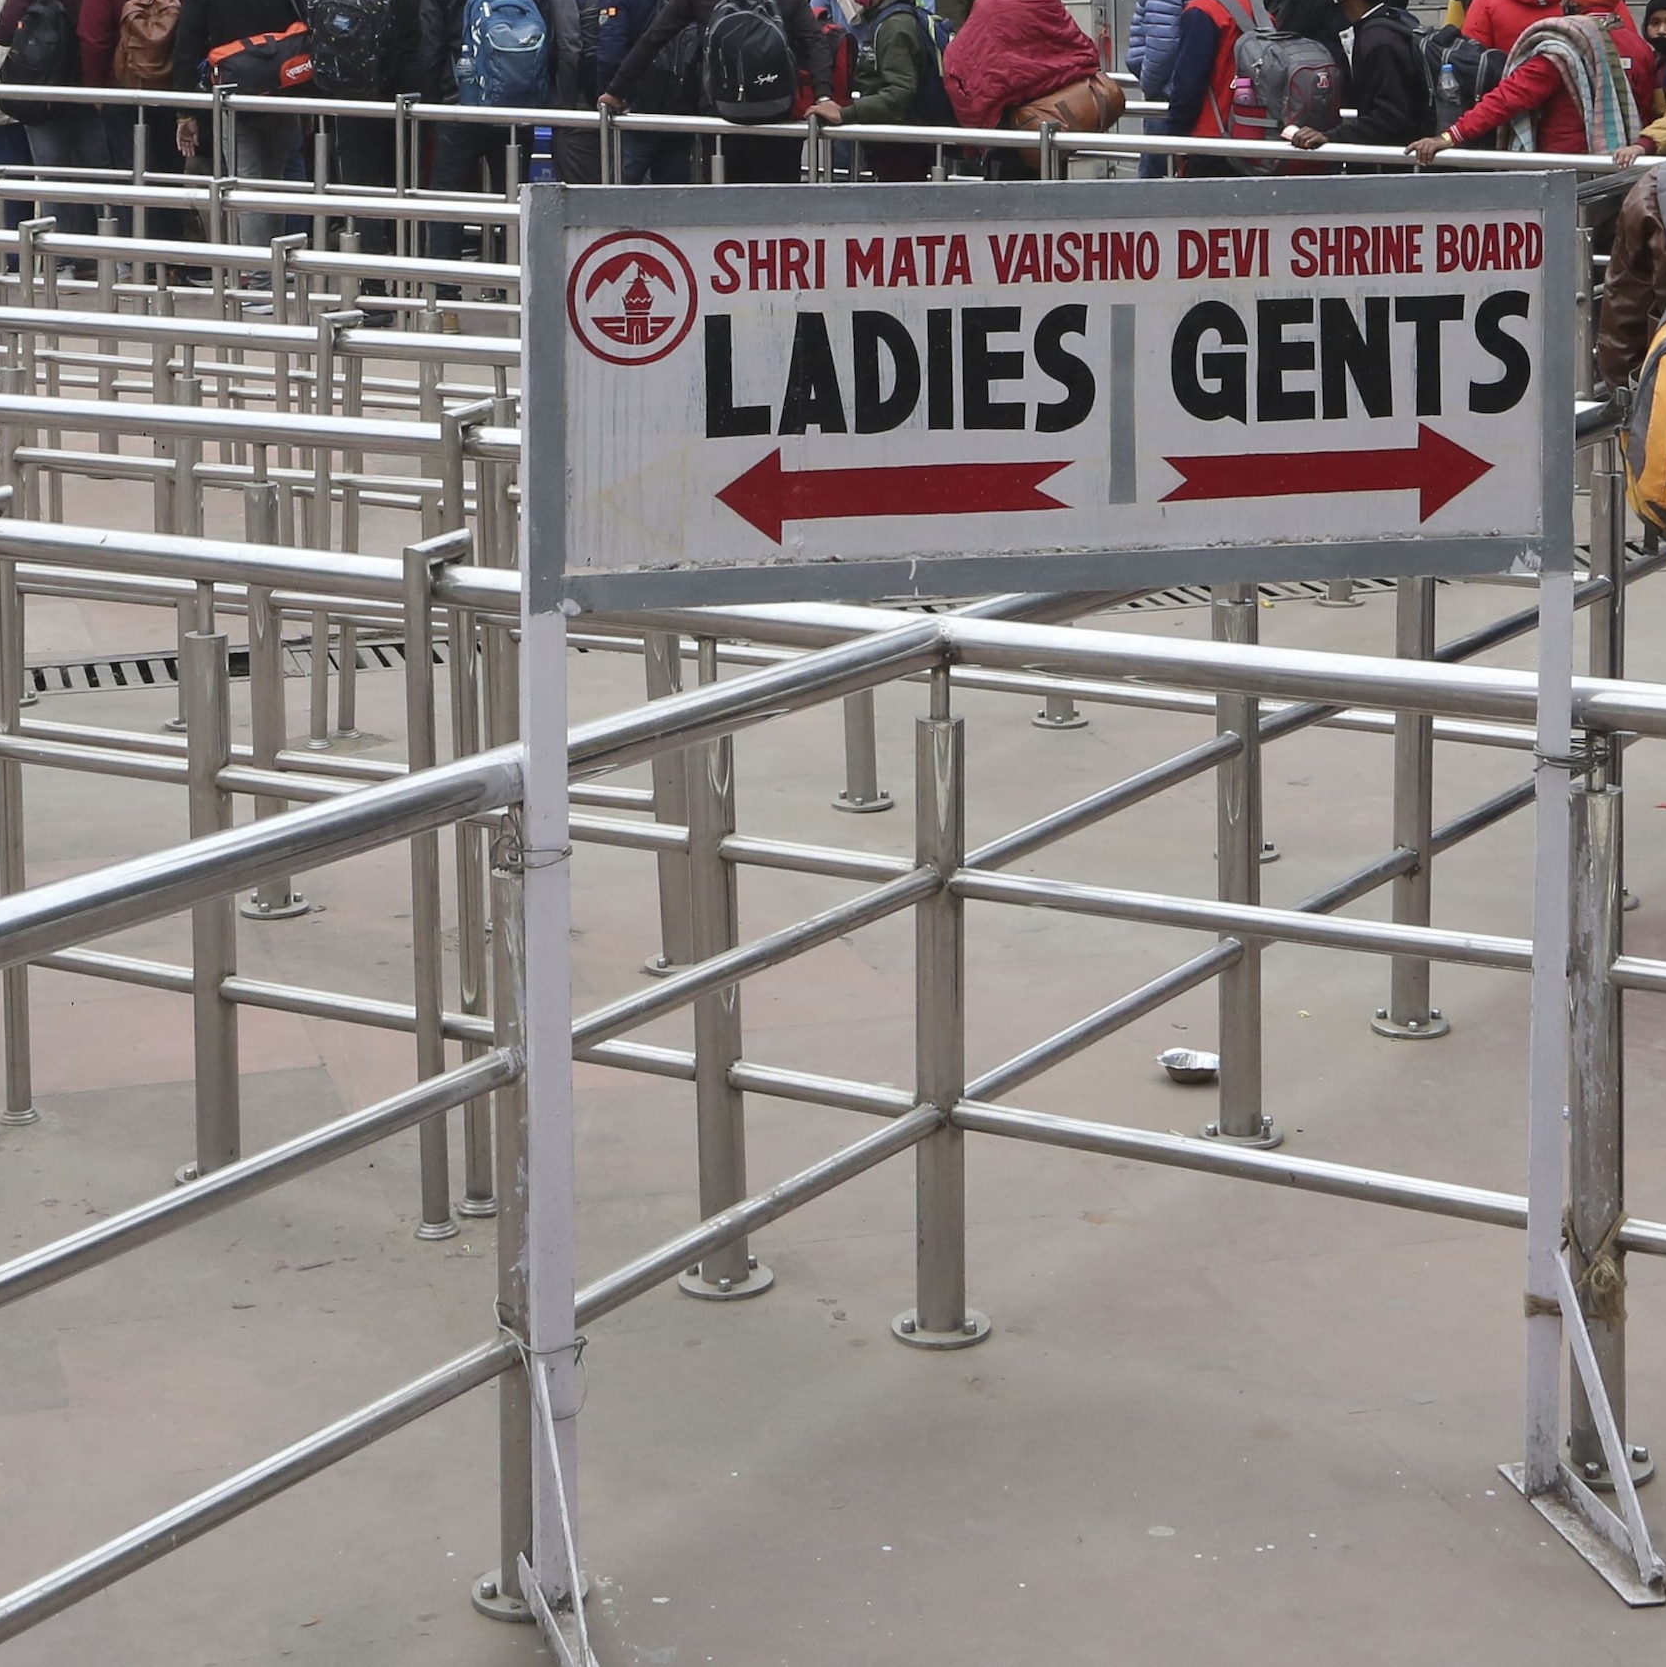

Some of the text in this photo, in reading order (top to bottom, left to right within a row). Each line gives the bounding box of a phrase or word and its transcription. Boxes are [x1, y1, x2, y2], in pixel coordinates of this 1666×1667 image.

[710, 221, 1542, 294] SHRI MATA VAISHNO DEVI SHRINE BOARD
[704, 290, 1531, 439] LADIES GENTS
